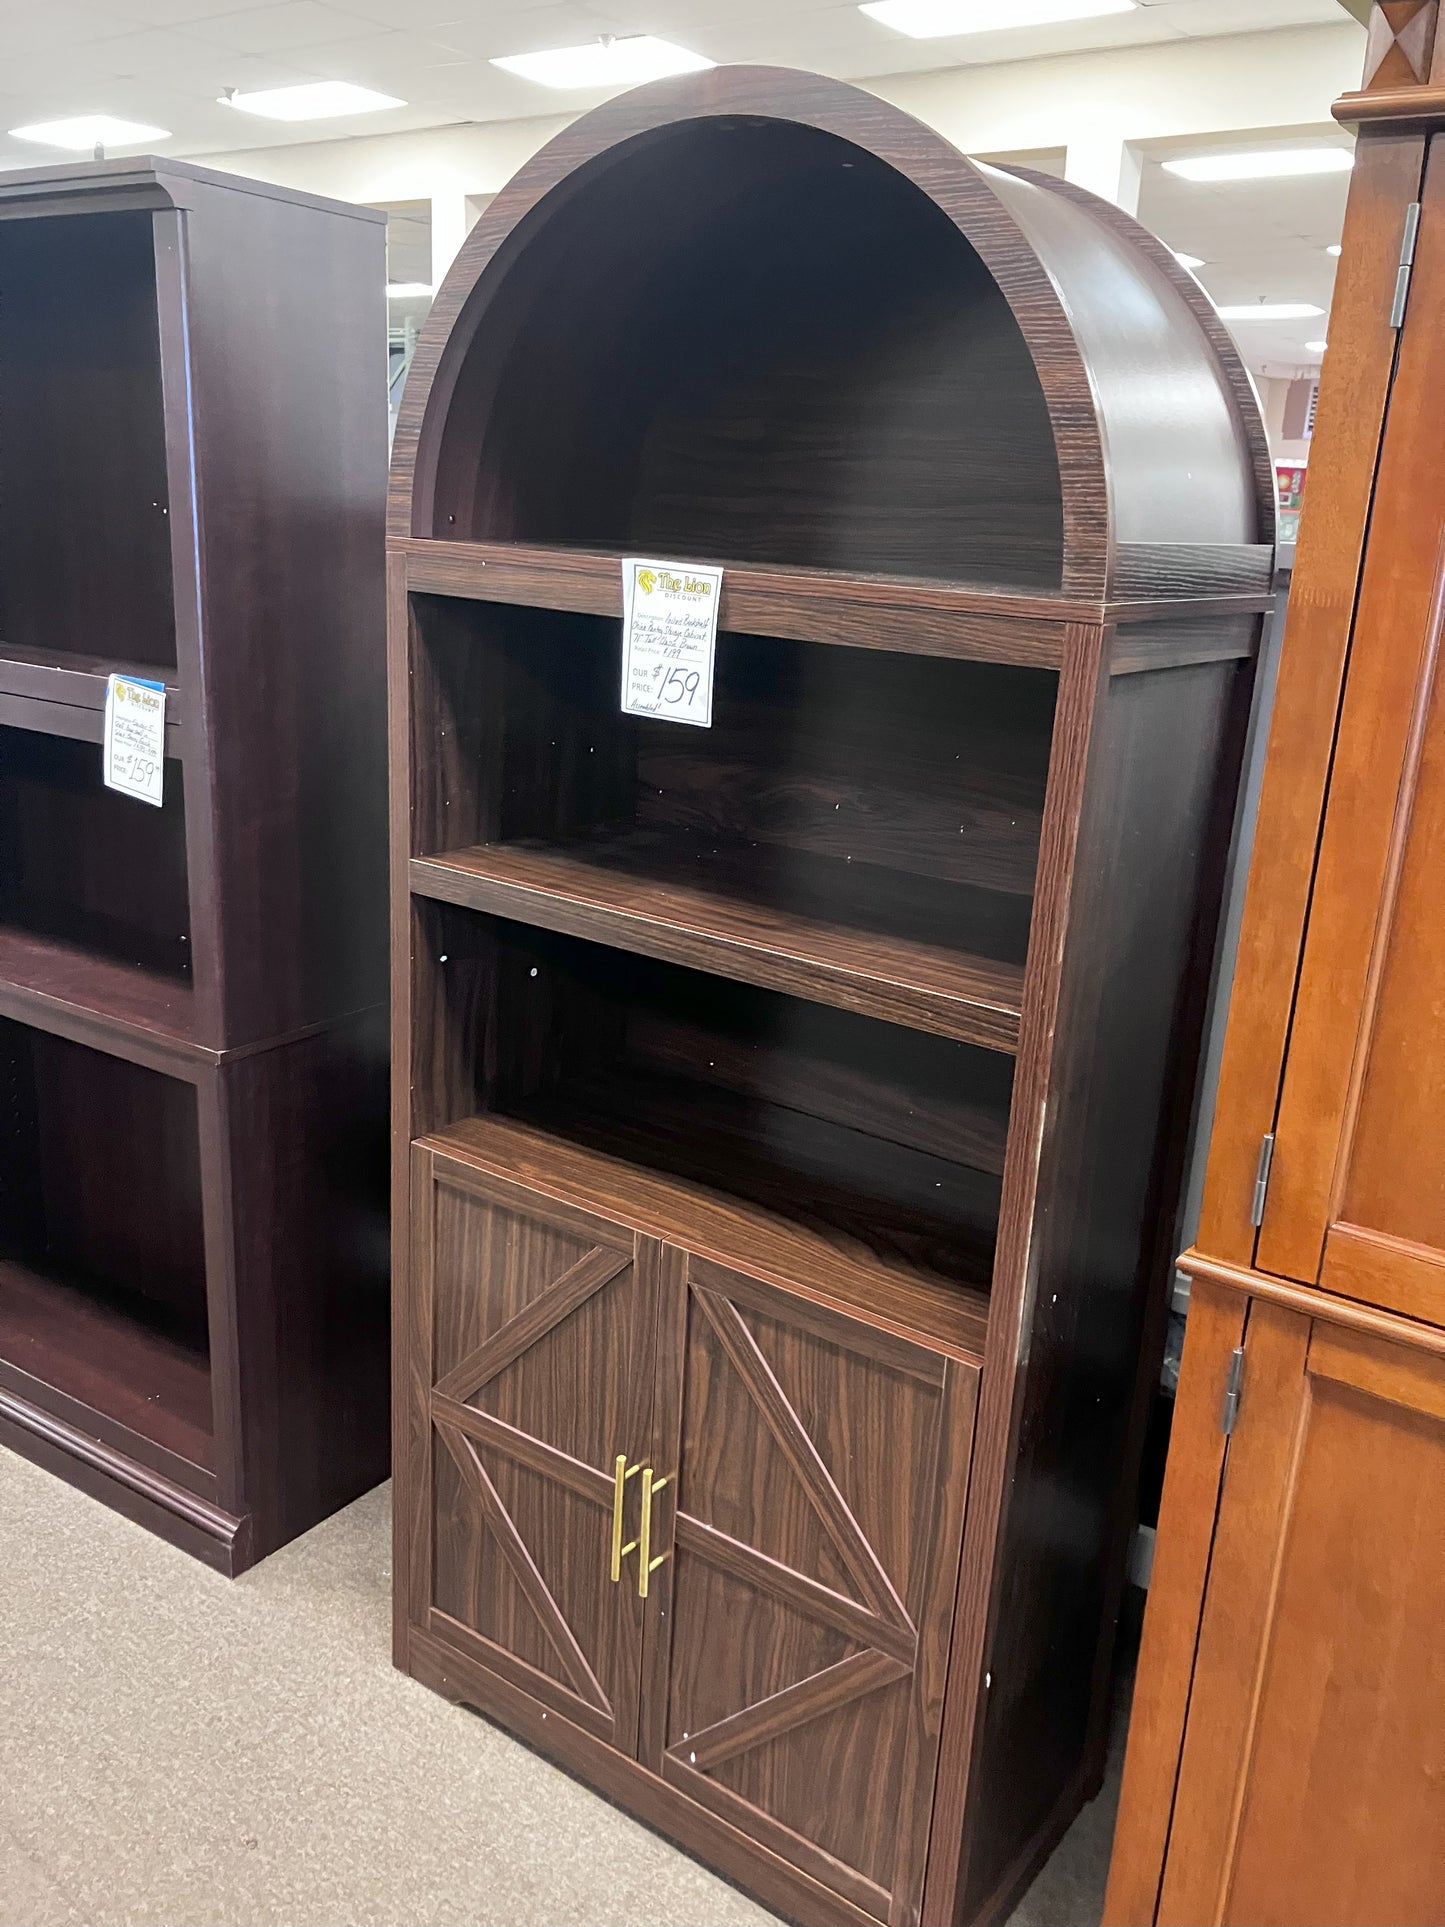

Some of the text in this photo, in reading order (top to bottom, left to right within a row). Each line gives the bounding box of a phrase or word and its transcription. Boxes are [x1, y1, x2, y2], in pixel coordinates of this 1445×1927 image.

[658, 572, 711, 595] The Lion
[664, 593, 702, 602] DISCOUNT
[633, 667, 648, 677] OUR
[631, 682, 653, 693] PRICE:
